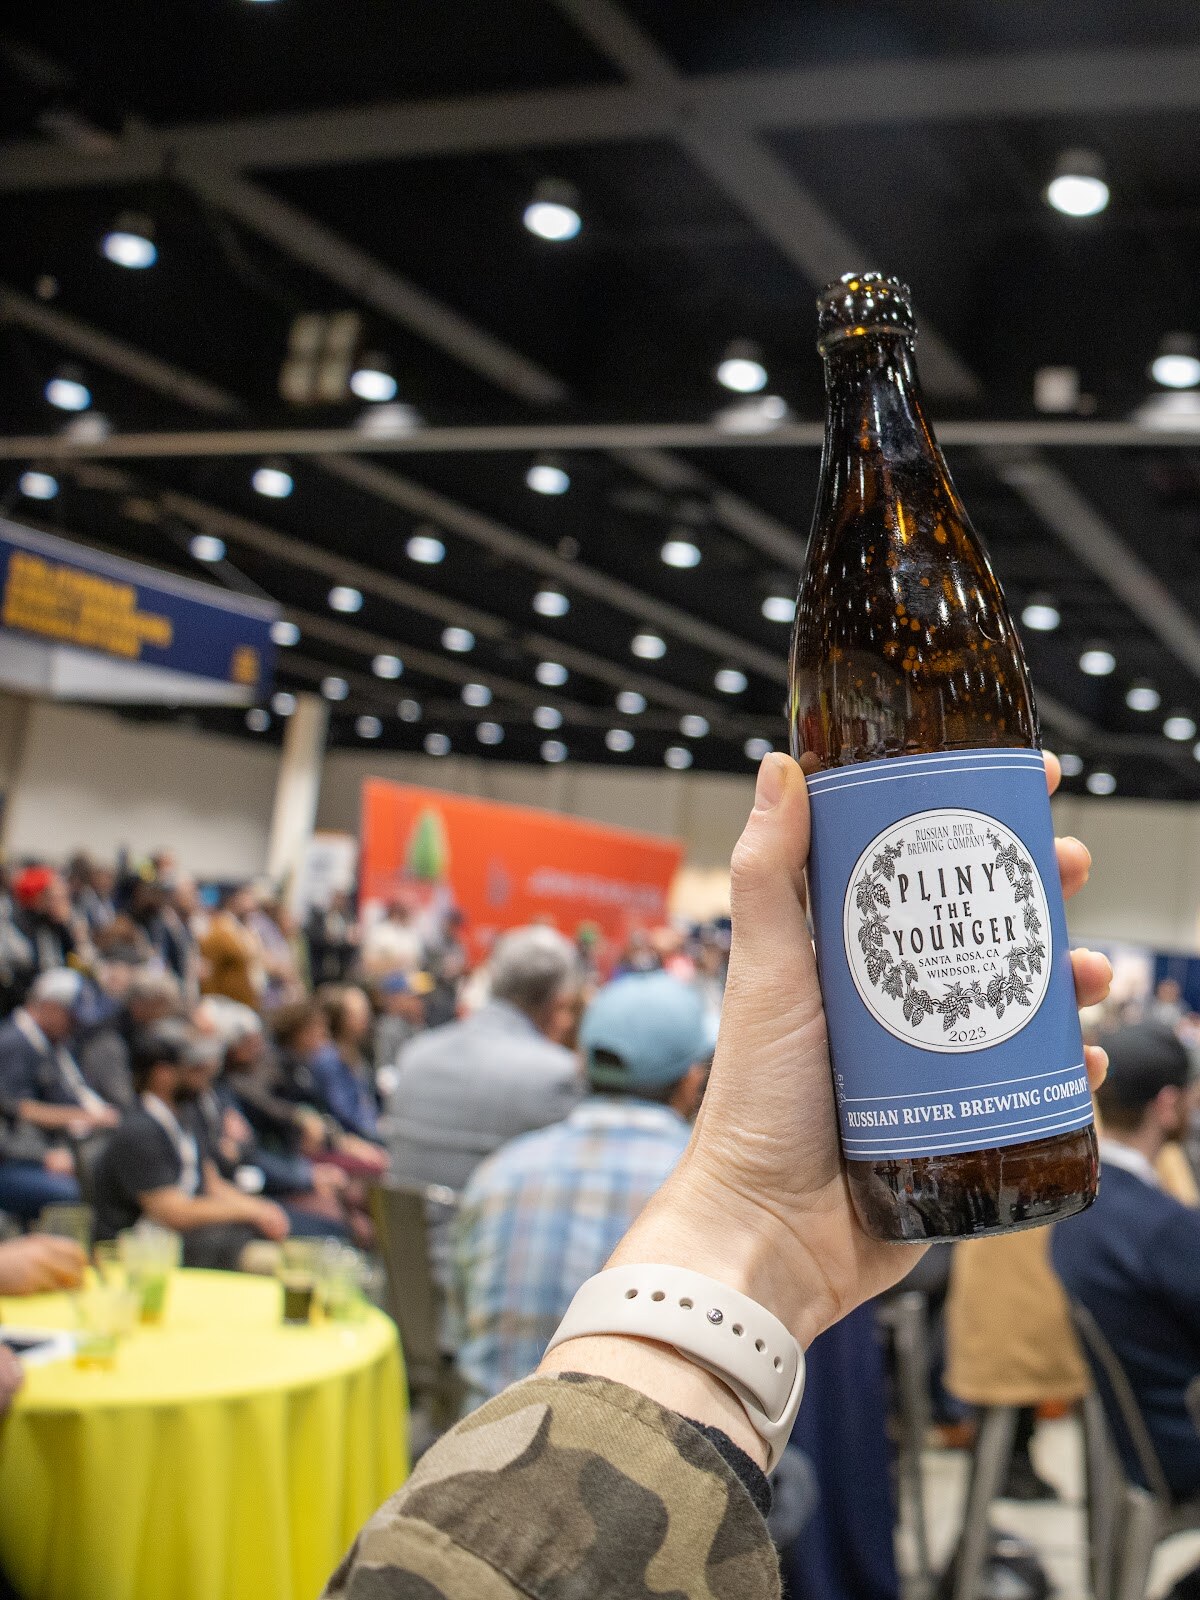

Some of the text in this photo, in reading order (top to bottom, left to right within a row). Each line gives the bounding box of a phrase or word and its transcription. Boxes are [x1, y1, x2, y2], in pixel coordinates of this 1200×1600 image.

[915, 823, 975, 842] RUSSIAN RIVER
[907, 835, 985, 855] BREWING COMPANY
[897, 863, 995, 903] PLINY
[933, 901, 972, 920] THE
[893, 916, 1016, 956] YOUNGER
[918, 948, 1000, 968] SANTA ROSA, CA
[927, 962, 997, 979] WINDSOR, CA
[948, 1026, 987, 1043] 2023
[847, 1076, 1088, 1127] RUSSIAN RIVER BREWING COMPANY
